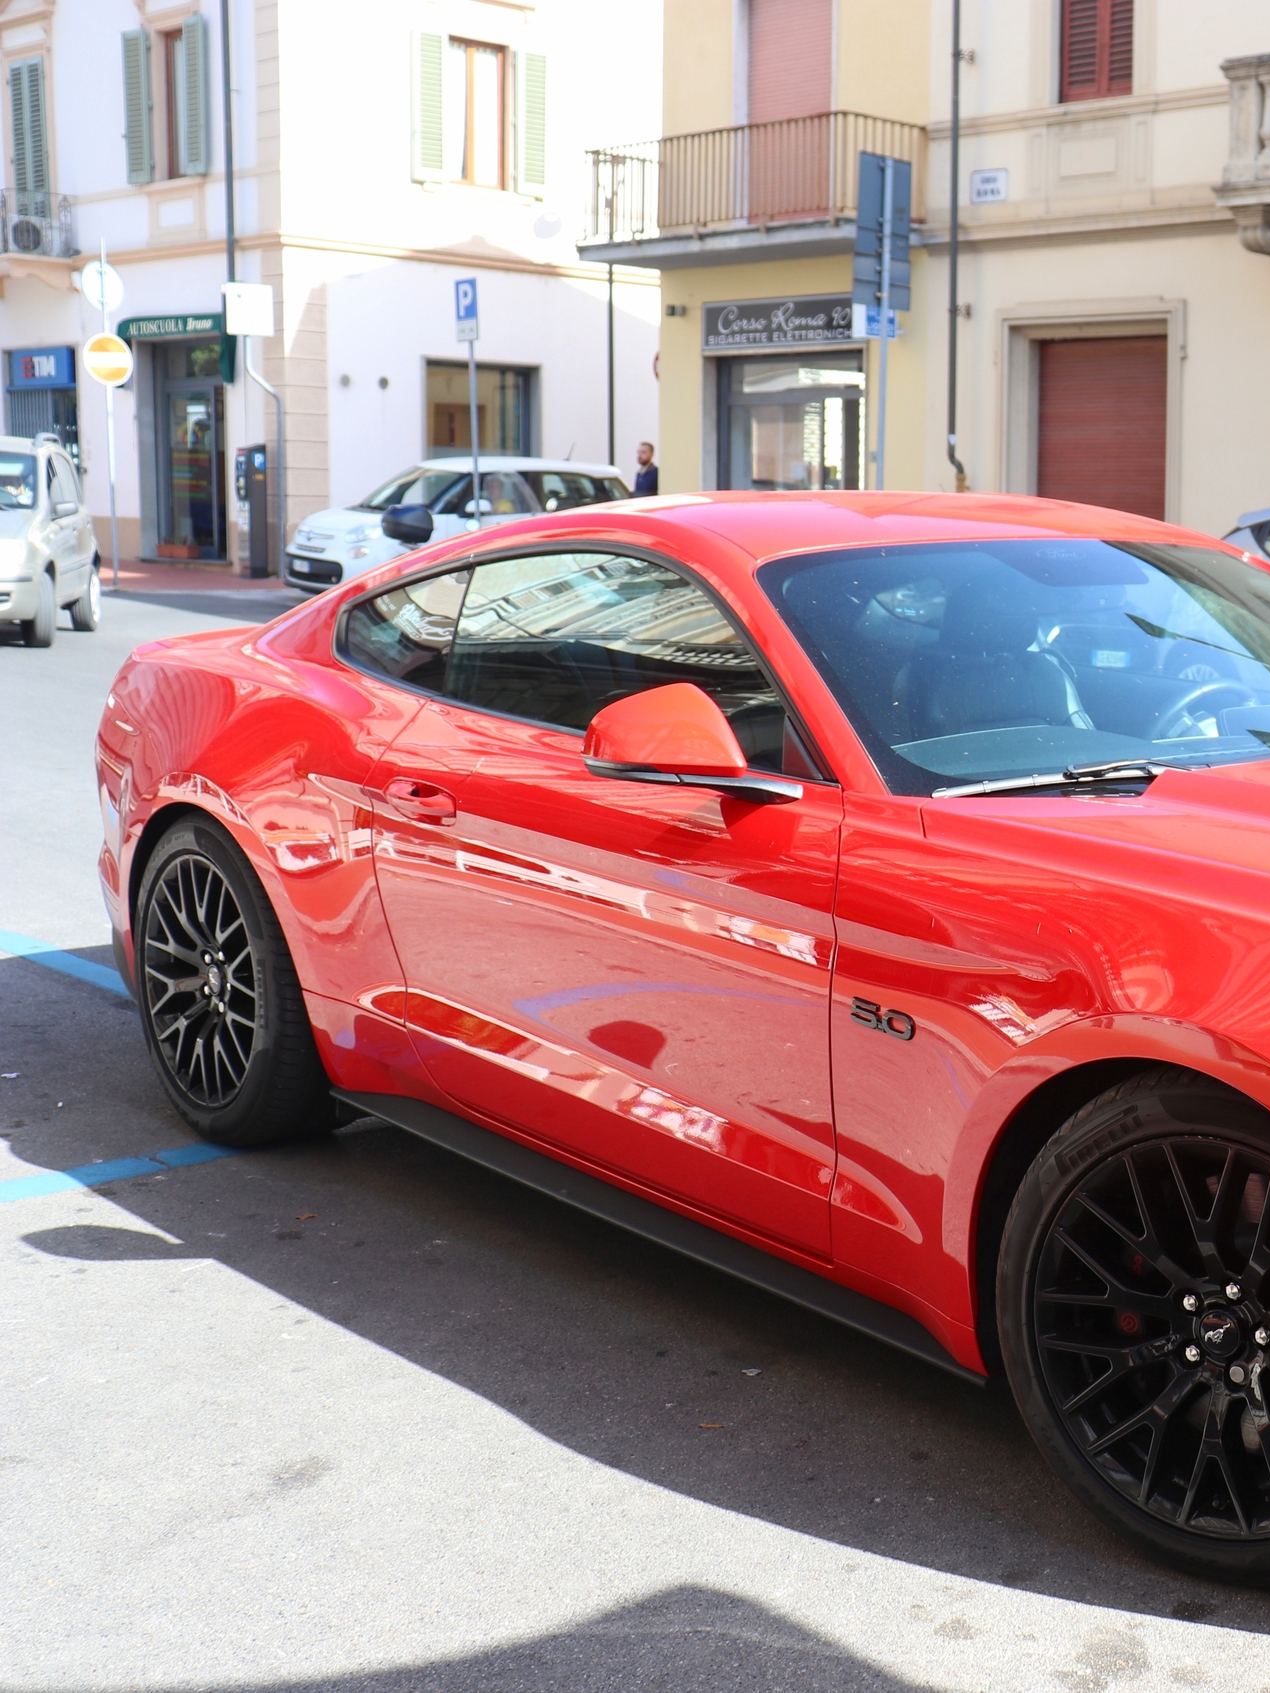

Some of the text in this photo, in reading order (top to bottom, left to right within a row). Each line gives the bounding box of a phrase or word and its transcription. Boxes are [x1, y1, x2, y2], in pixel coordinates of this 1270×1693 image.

[459, 283, 473, 316] P
[127, 317, 213, 335] AUTOSCUOLA Bruno
[718, 303, 851, 334] Corso Roma 90
[708, 331, 768, 345] SIGARETTE
[773, 327, 852, 341] ELETTRONICH
[32, 355, 55, 377] TIM
[851, 996, 916, 1041] 5.0
[1054, 1104, 1144, 1176] PIRELLI
